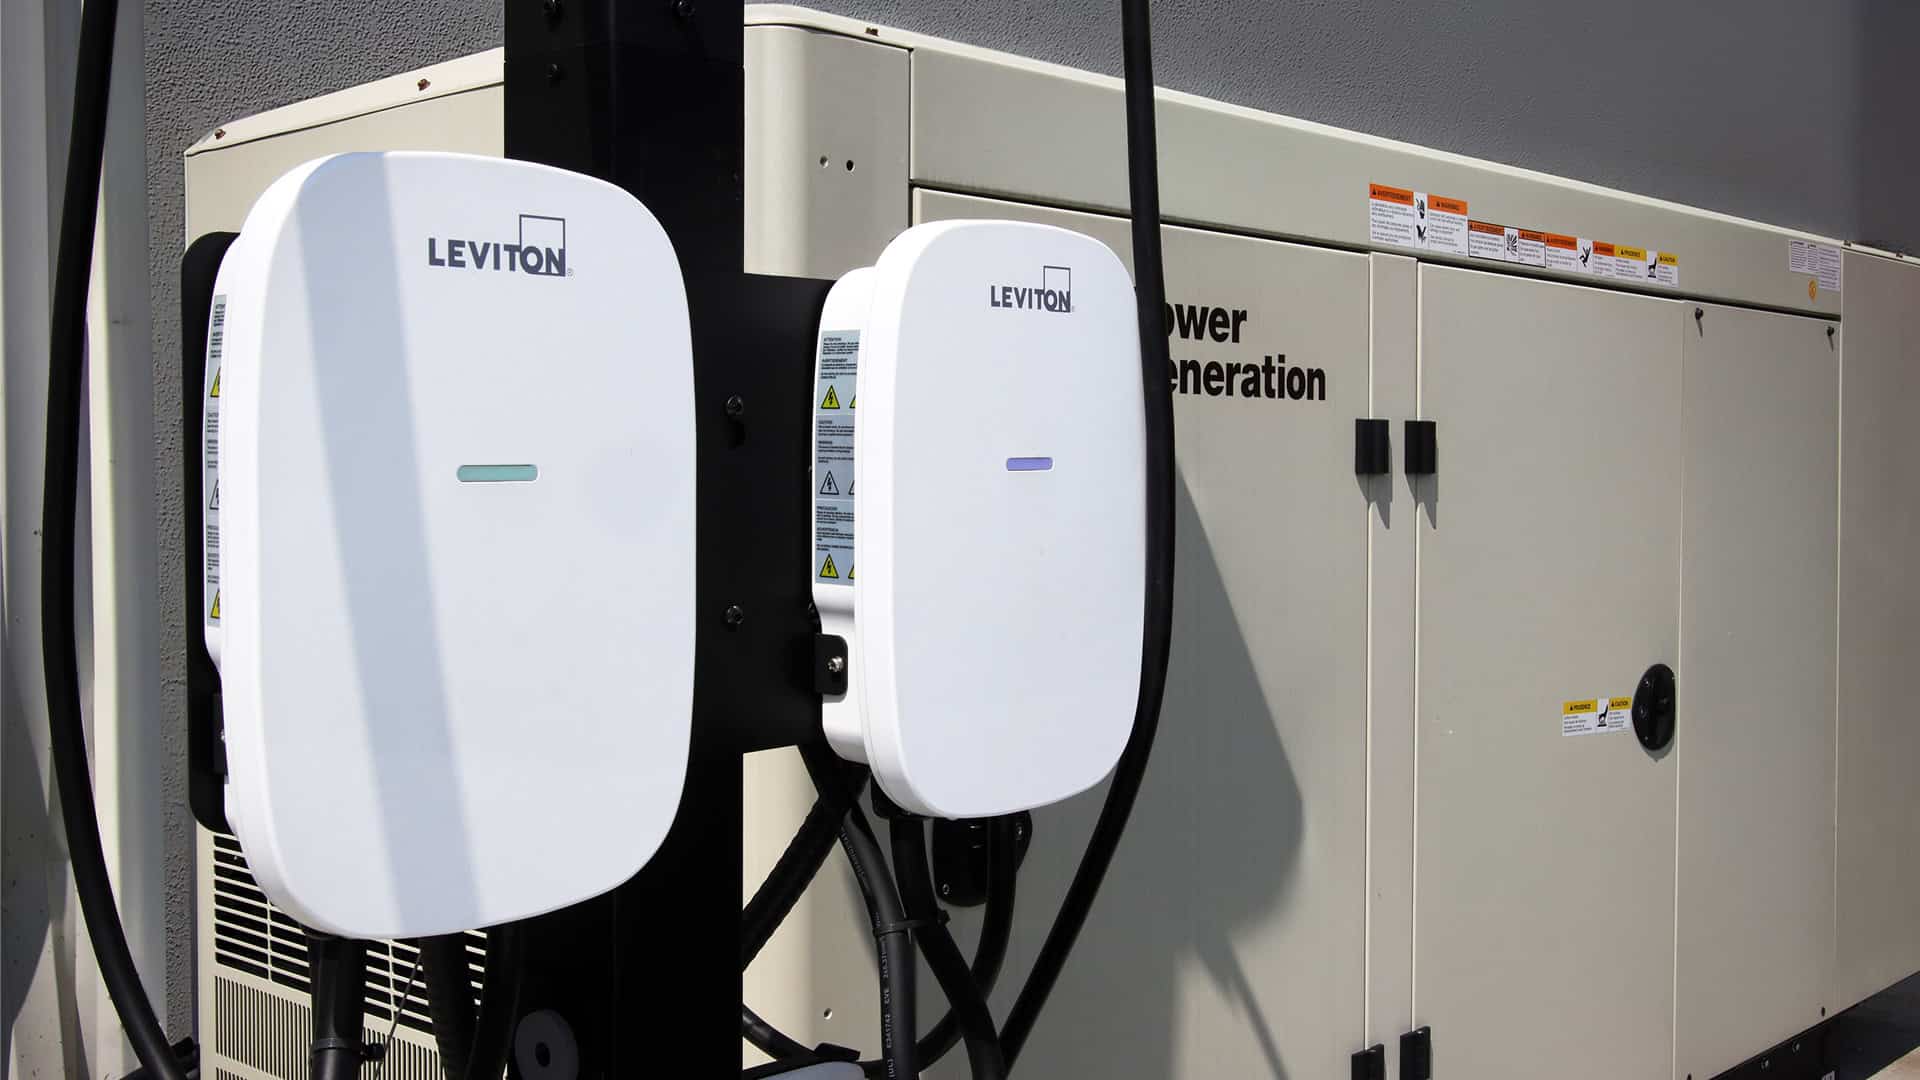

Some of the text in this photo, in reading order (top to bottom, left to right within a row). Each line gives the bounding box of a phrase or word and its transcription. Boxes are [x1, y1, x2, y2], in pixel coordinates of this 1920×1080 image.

[428, 237, 566, 277] LEVITON
[990, 284, 1071, 313] LEVITON
[1166, 303, 1248, 344] wer
[1168, 354, 1327, 401] neration
